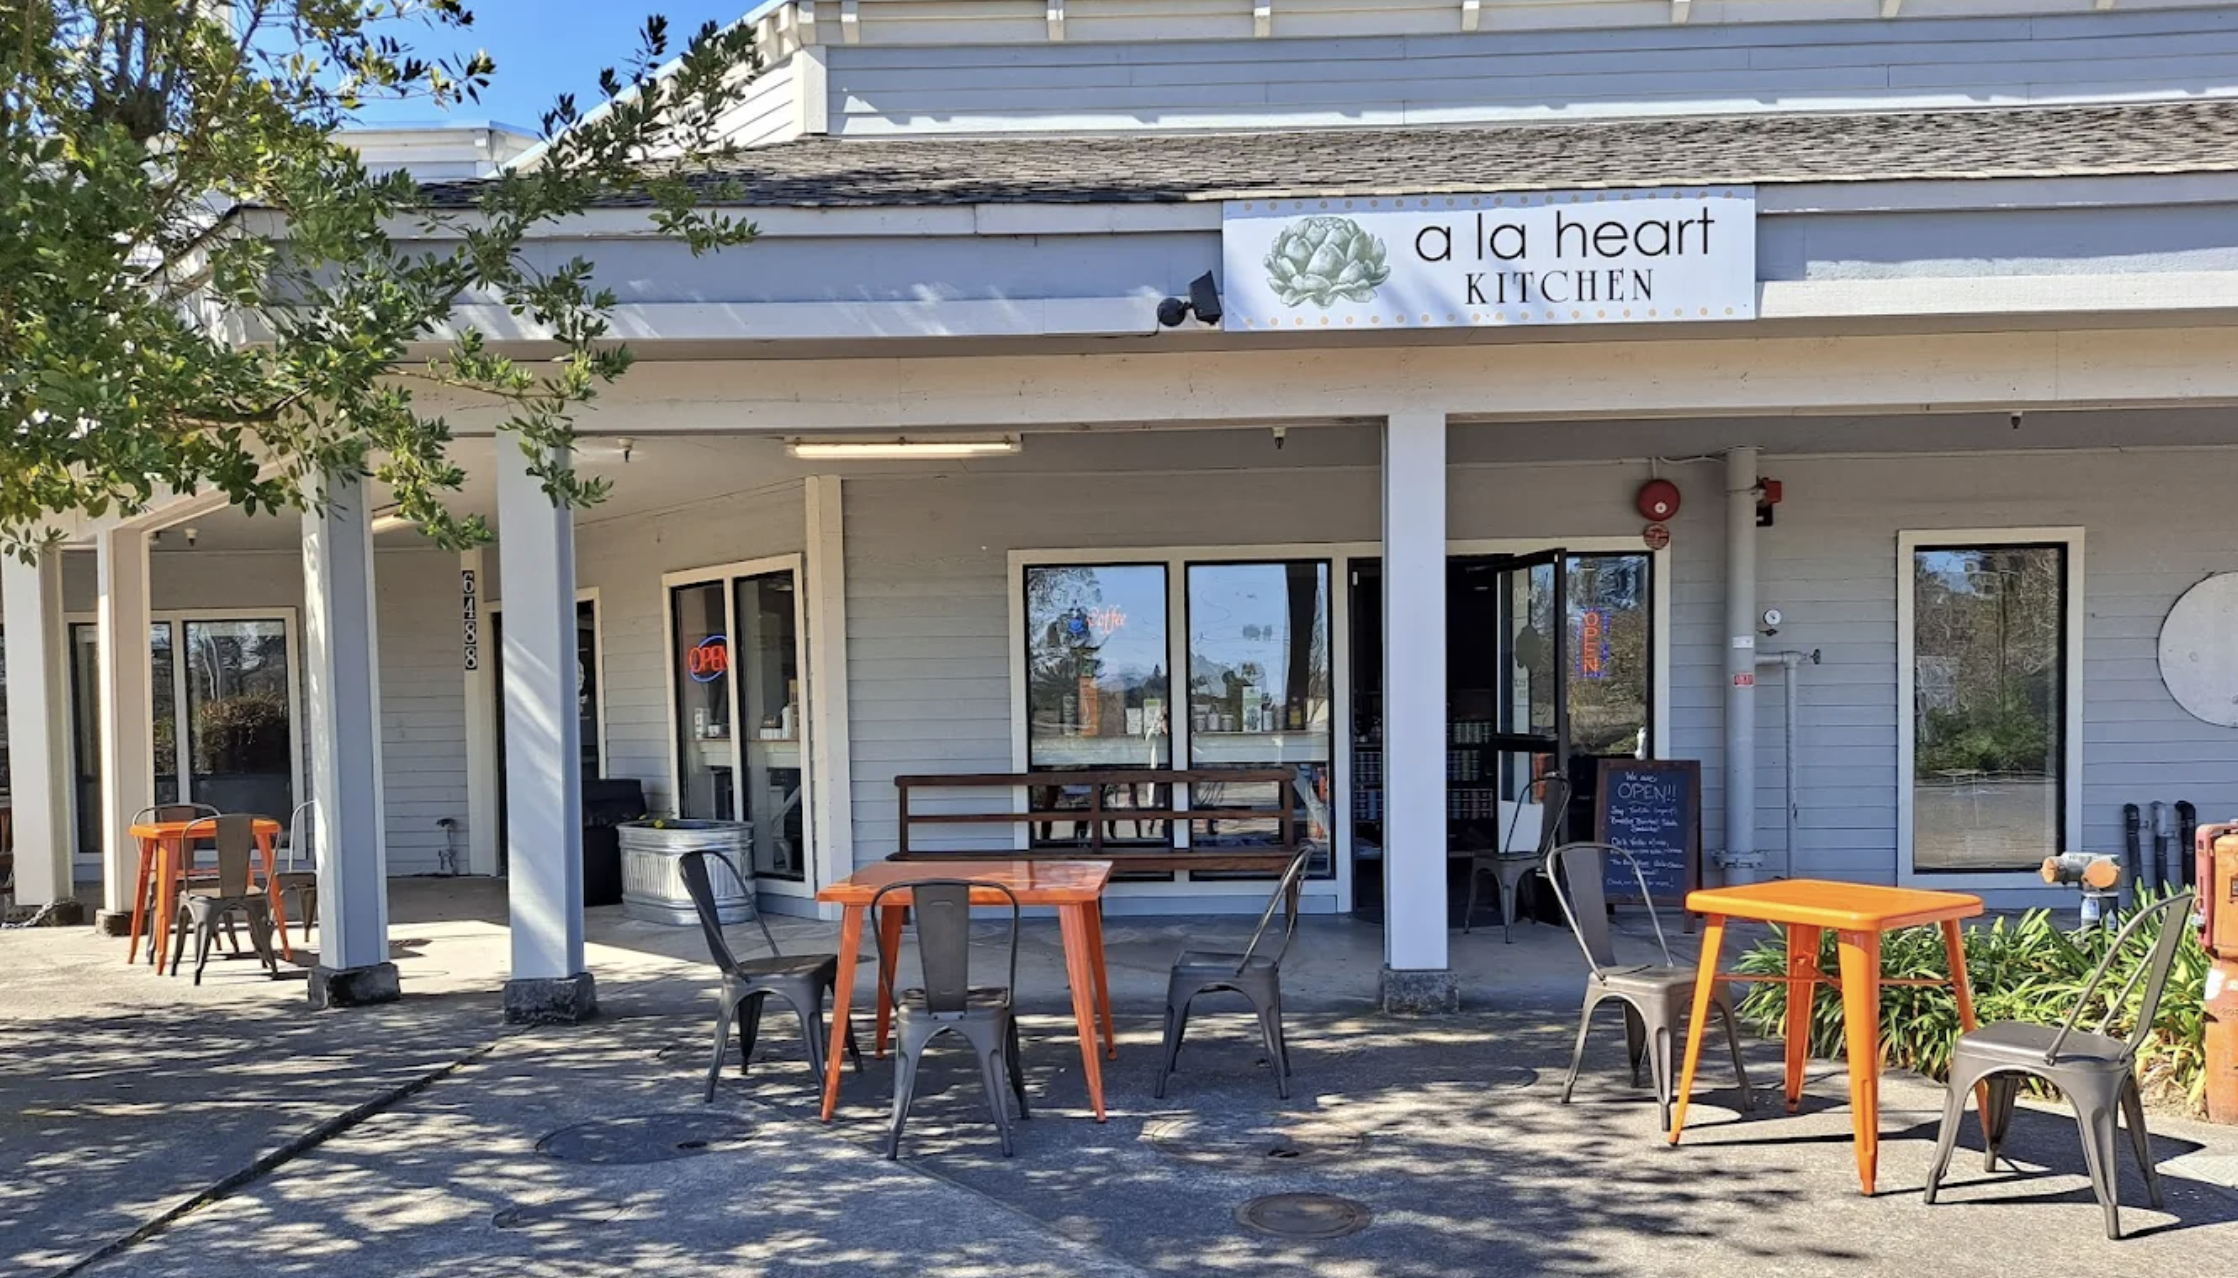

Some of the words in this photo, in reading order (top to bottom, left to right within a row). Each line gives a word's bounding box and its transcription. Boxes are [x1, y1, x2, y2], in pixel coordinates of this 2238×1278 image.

[1415, 226, 1451, 262] a
[1477, 212, 1526, 261] la
[1555, 206, 1715, 258] heart
[1465, 268, 1653, 305] KITCHEN
[463, 571, 477, 669] 6488
[1584, 611, 1600, 674] OPEN
[1617, 782, 1677, 803] OPEN!!
